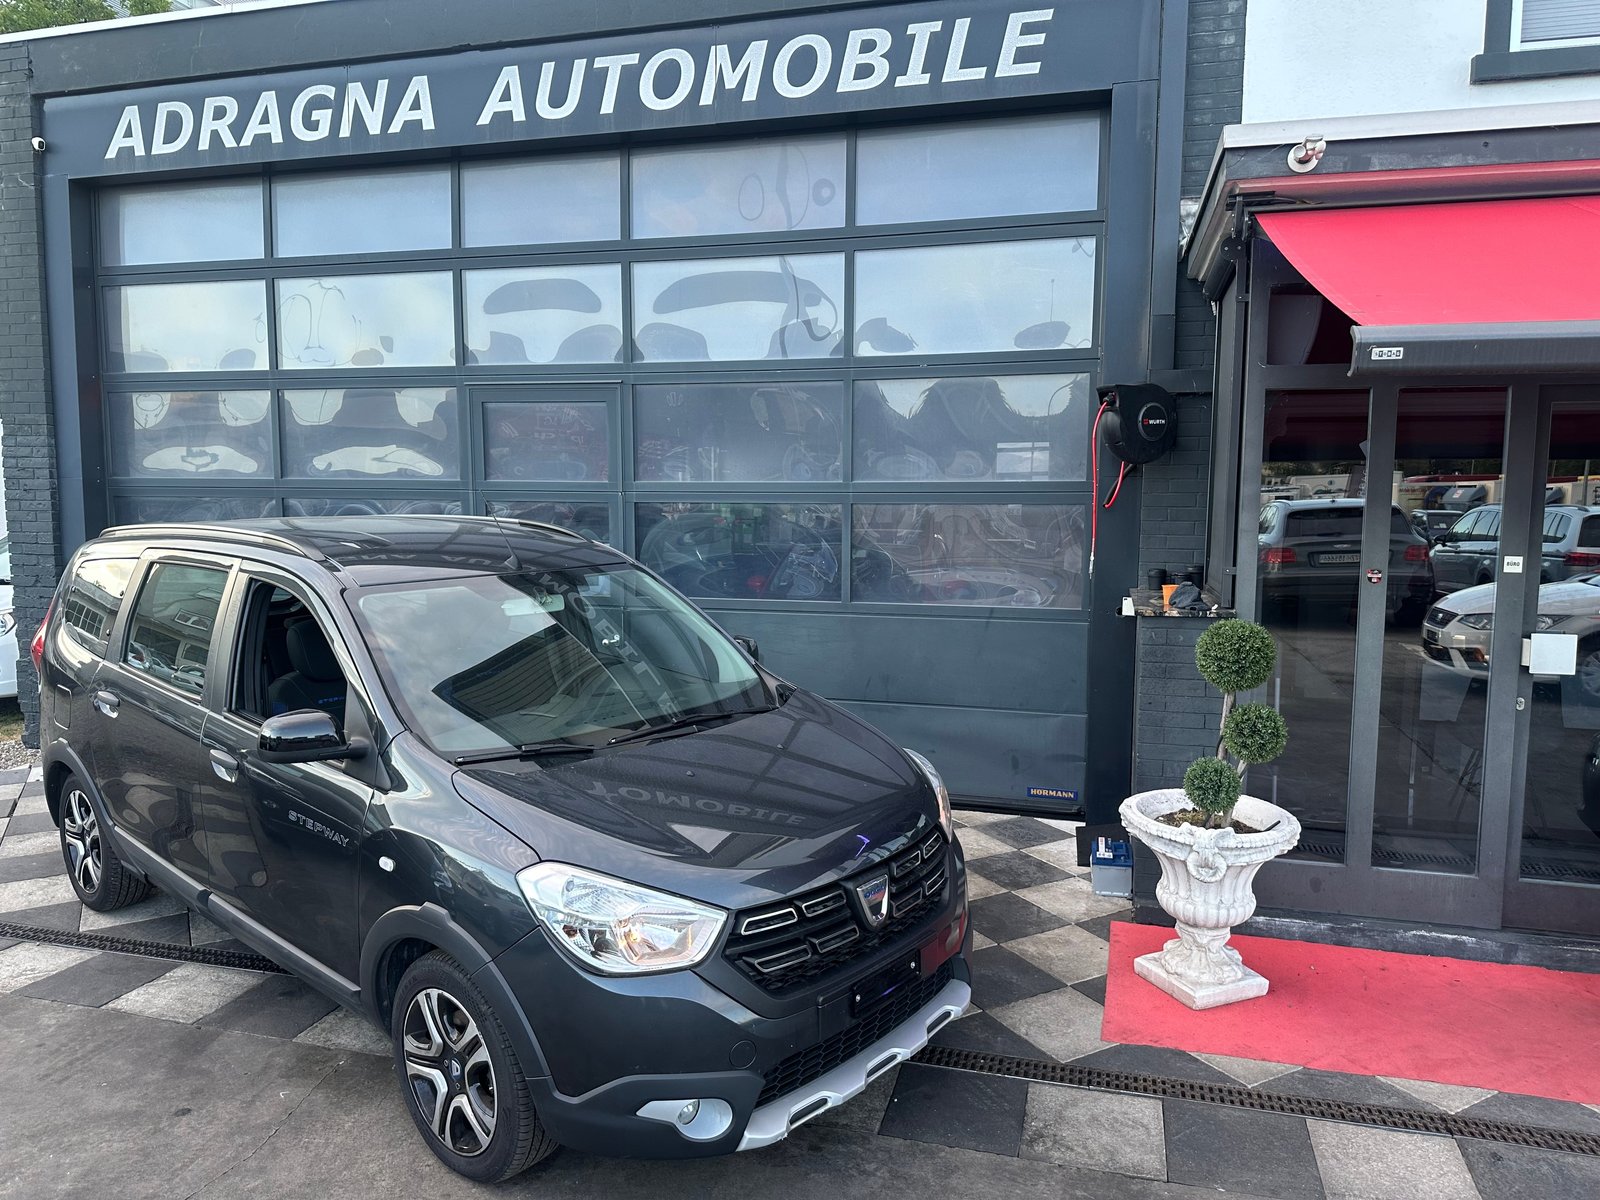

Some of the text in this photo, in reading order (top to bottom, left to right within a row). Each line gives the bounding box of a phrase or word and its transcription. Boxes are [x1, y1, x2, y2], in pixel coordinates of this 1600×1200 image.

[104, 8, 1054, 159] ADRAGNA AUTOMOBILE
[288, 810, 349, 847] STEPWAY
